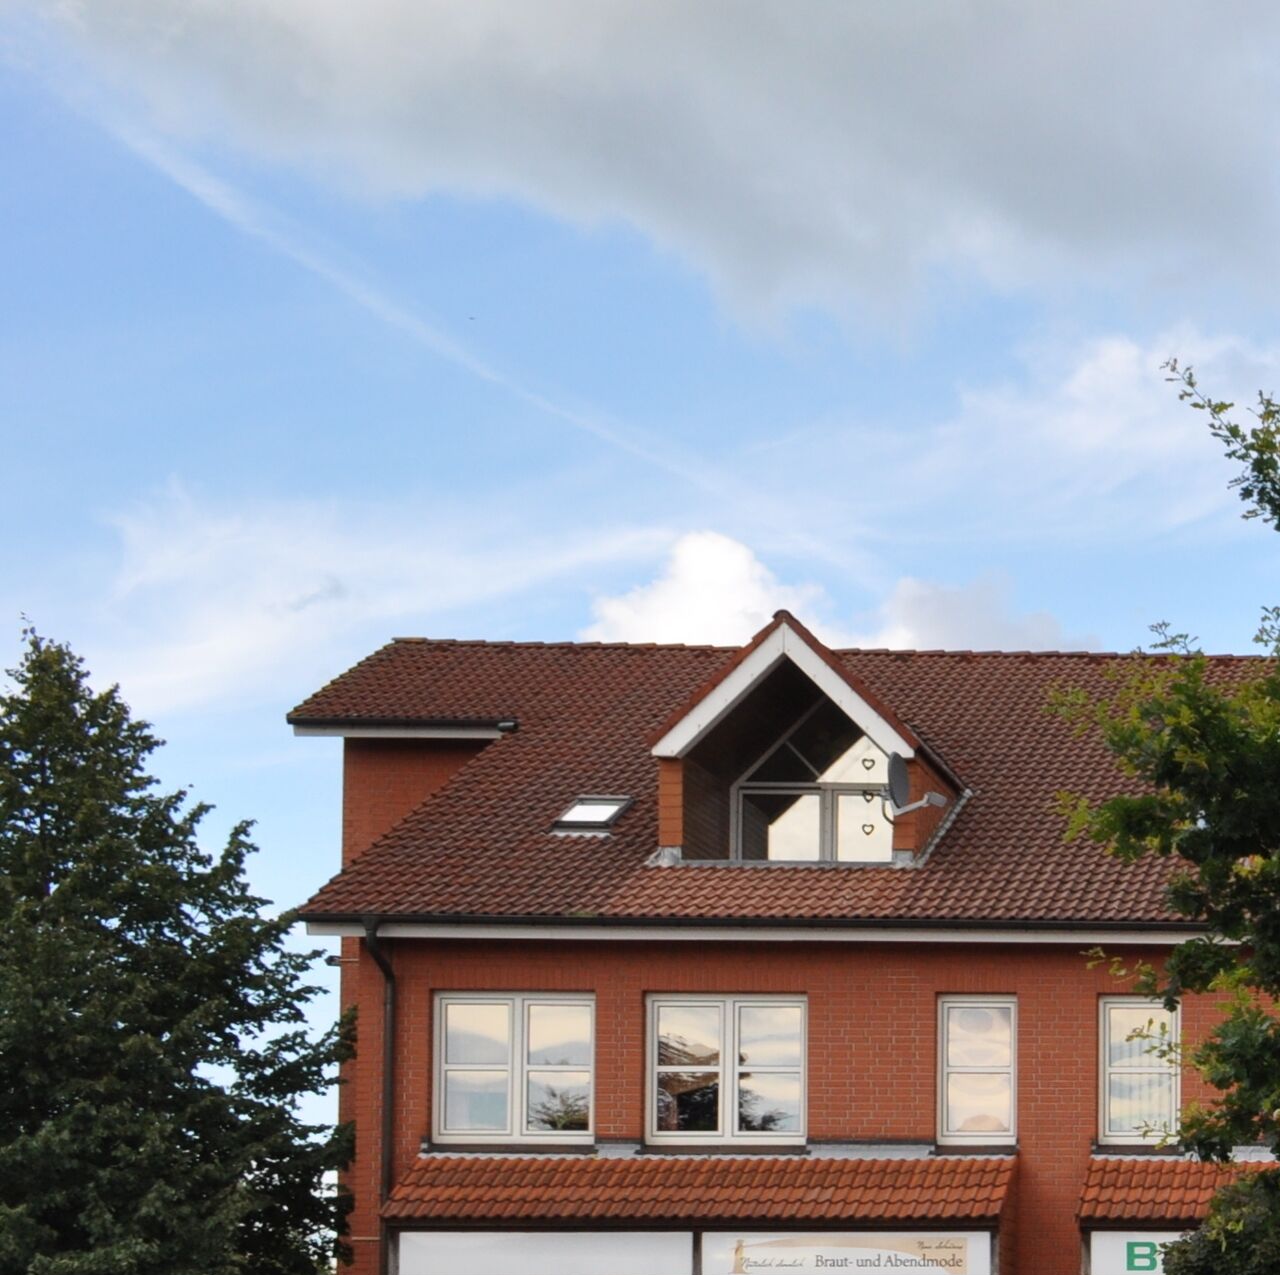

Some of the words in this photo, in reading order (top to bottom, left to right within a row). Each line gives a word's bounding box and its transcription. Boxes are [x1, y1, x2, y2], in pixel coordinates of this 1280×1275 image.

[814, 1254, 853, 1268] Braut-
[856, 1254, 881, 1268] und
[883, 1253, 963, 1268] Abendmode
